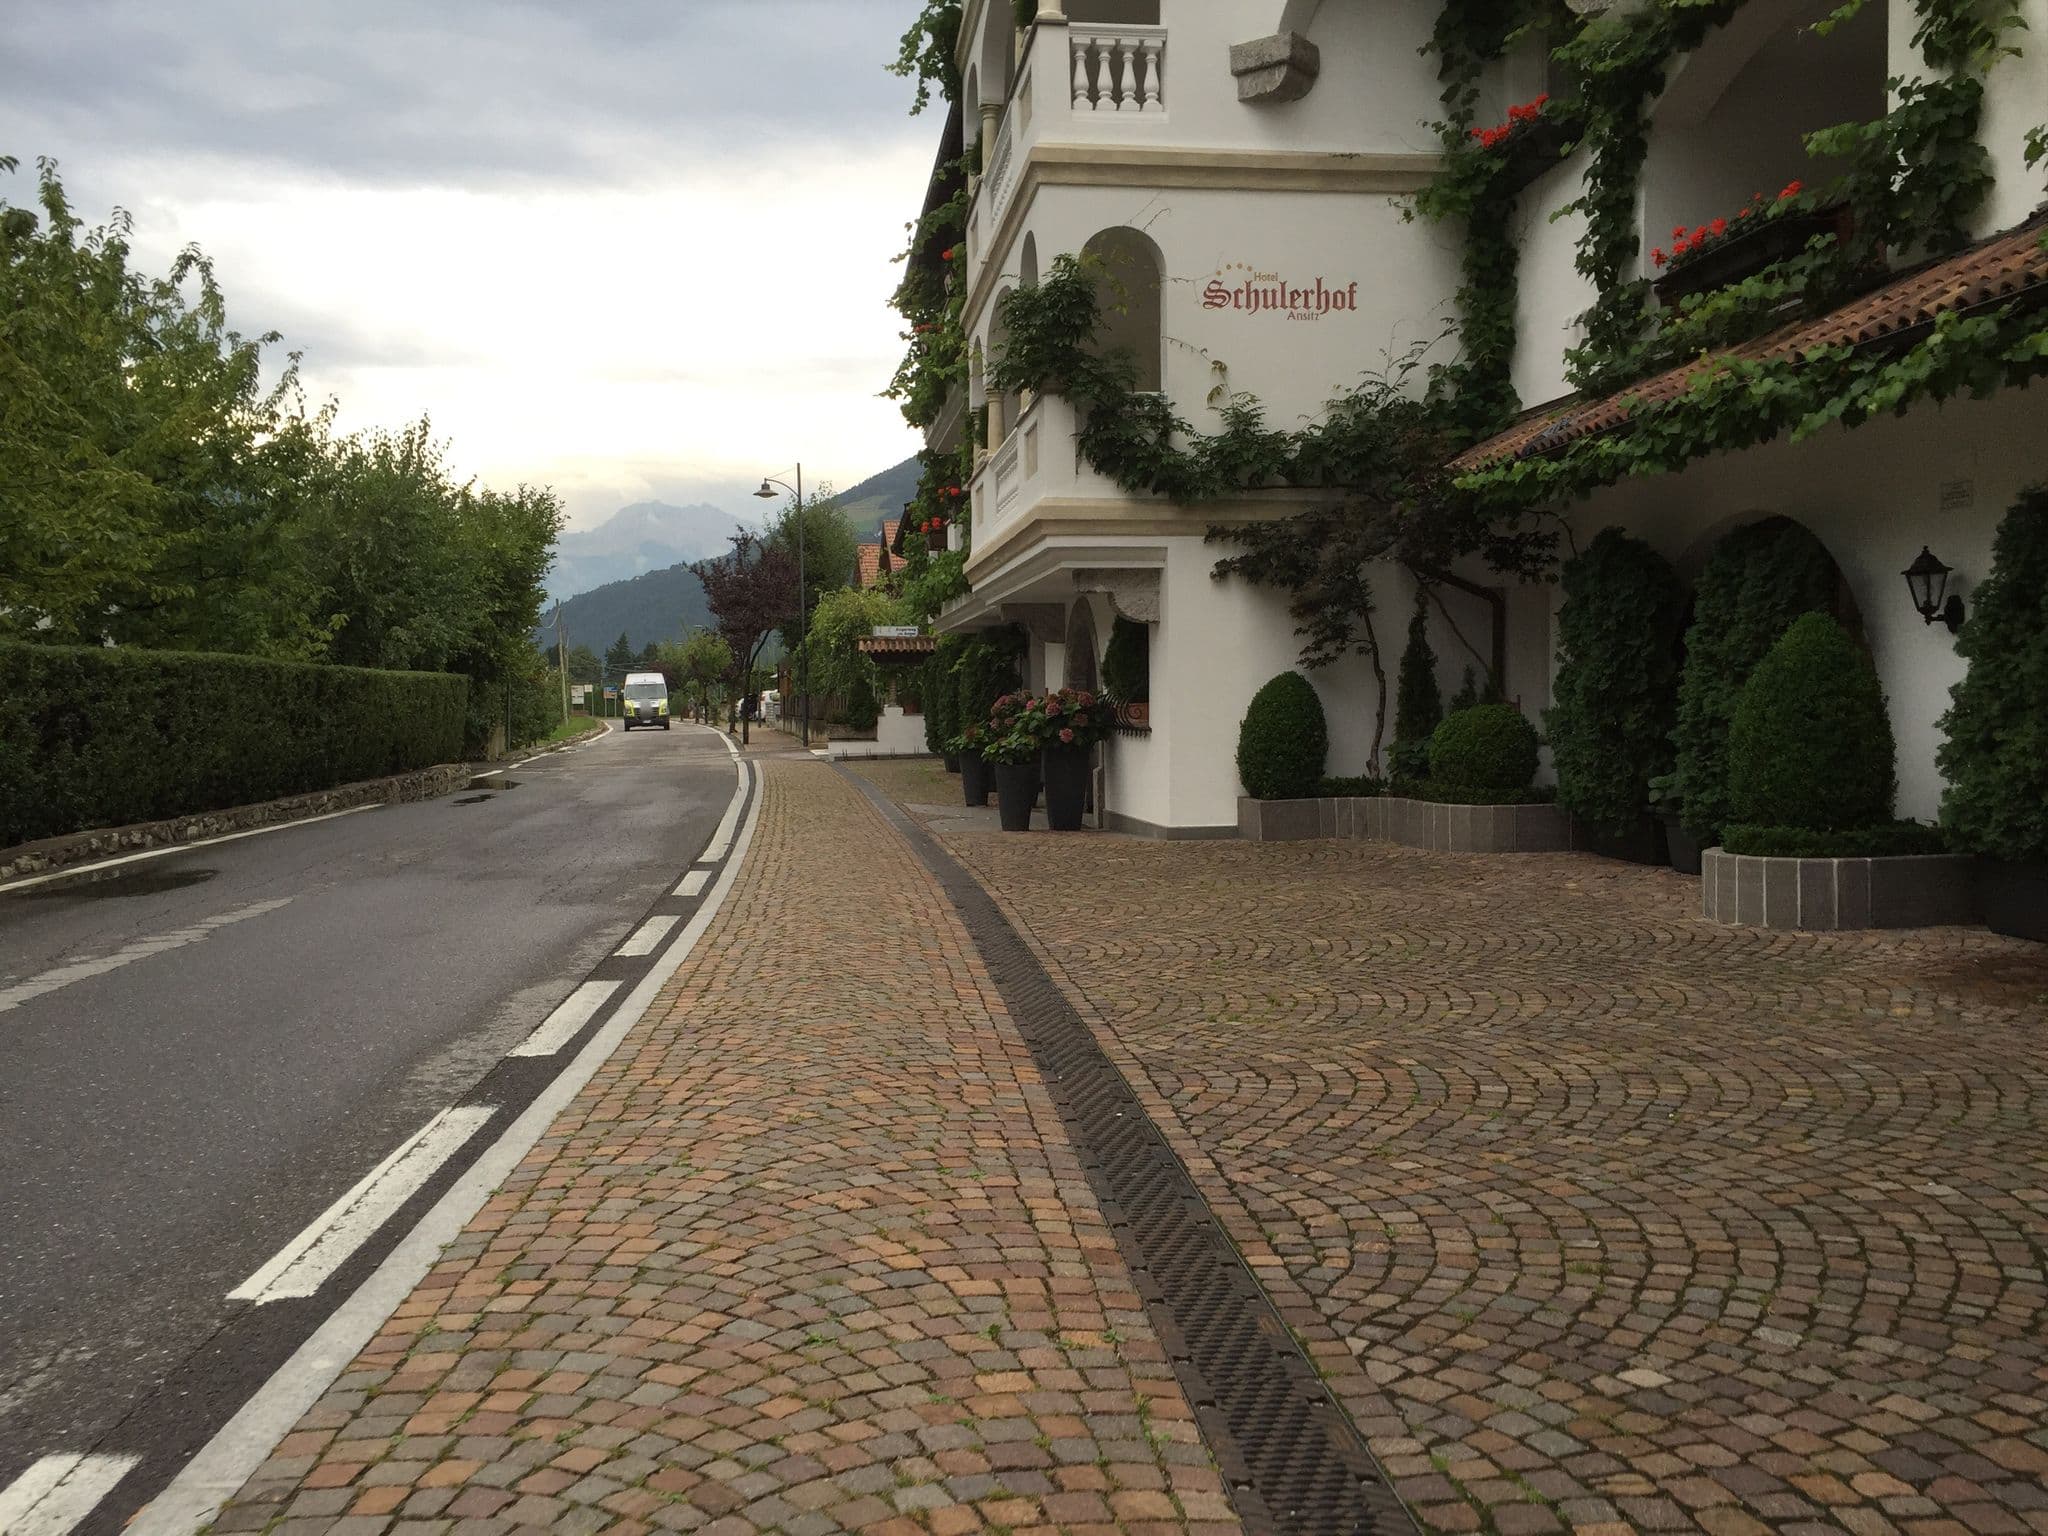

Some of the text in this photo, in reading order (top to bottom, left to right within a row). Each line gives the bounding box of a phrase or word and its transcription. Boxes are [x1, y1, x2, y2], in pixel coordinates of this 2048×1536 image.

[1254, 272, 1279, 282] Hotel
[1202, 276, 1358, 315] Schulerhof
[1287, 311, 1320, 321] Ansitz
